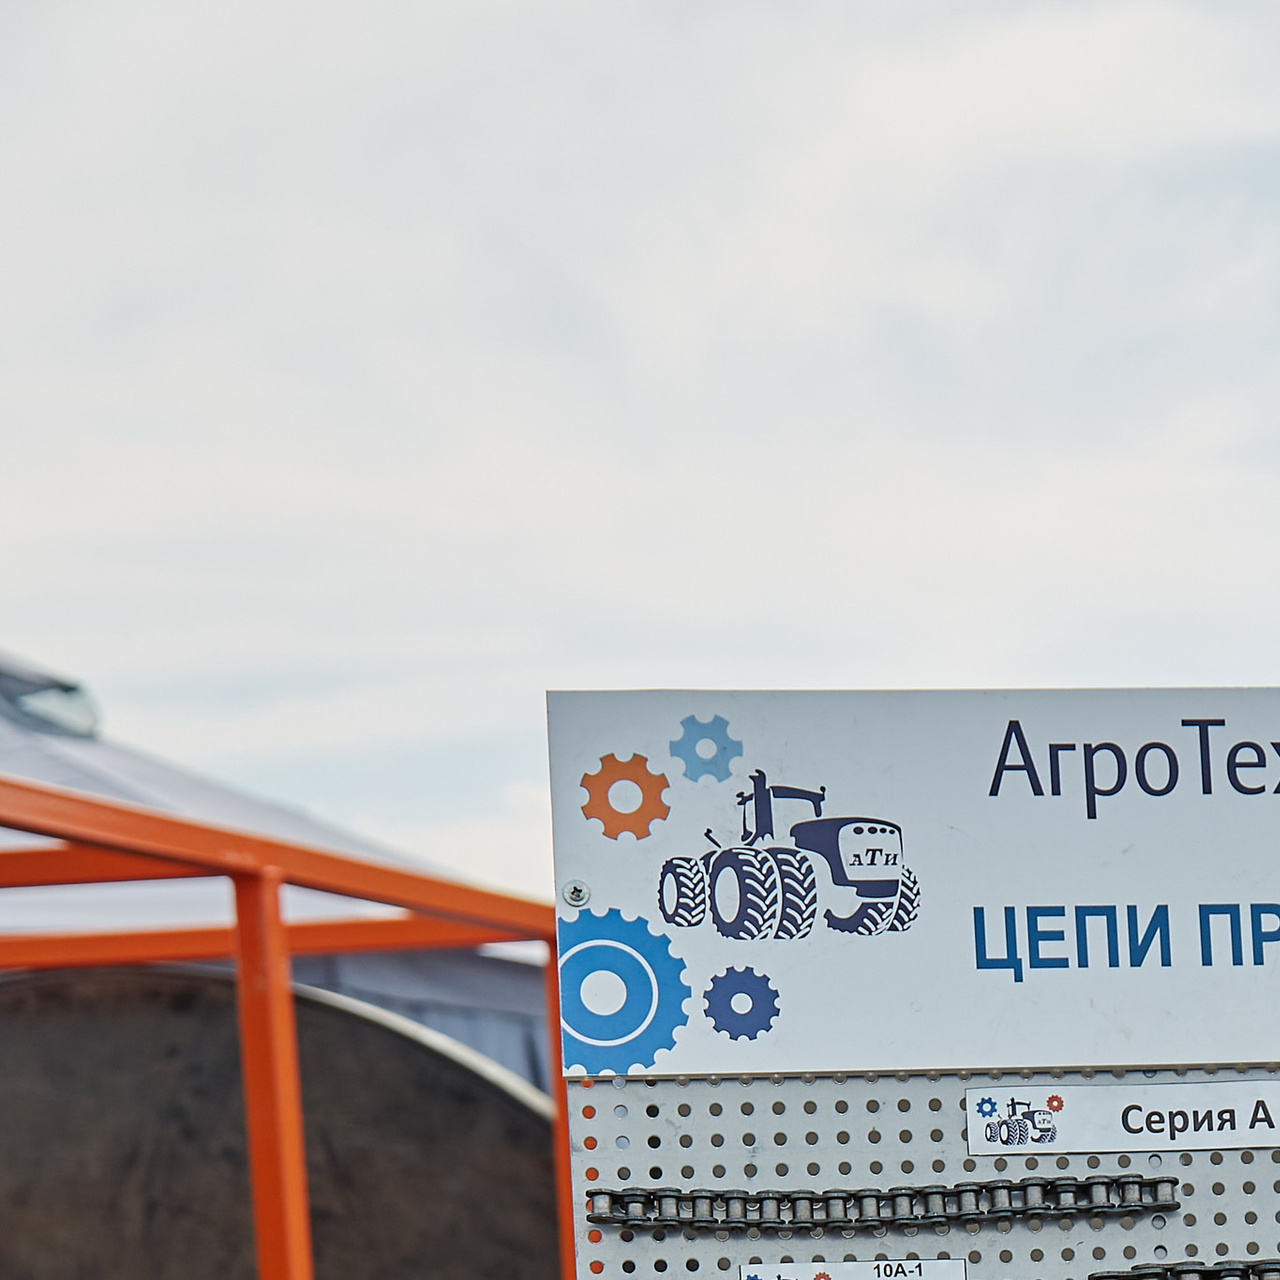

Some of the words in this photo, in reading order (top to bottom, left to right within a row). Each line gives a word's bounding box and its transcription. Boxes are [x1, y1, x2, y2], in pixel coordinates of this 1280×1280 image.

[973, 904, 1172, 982] ЦЕПИ
[1121, 1104, 1236, 1141] Серия
[873, 1262, 922, 1278] 10A-1
